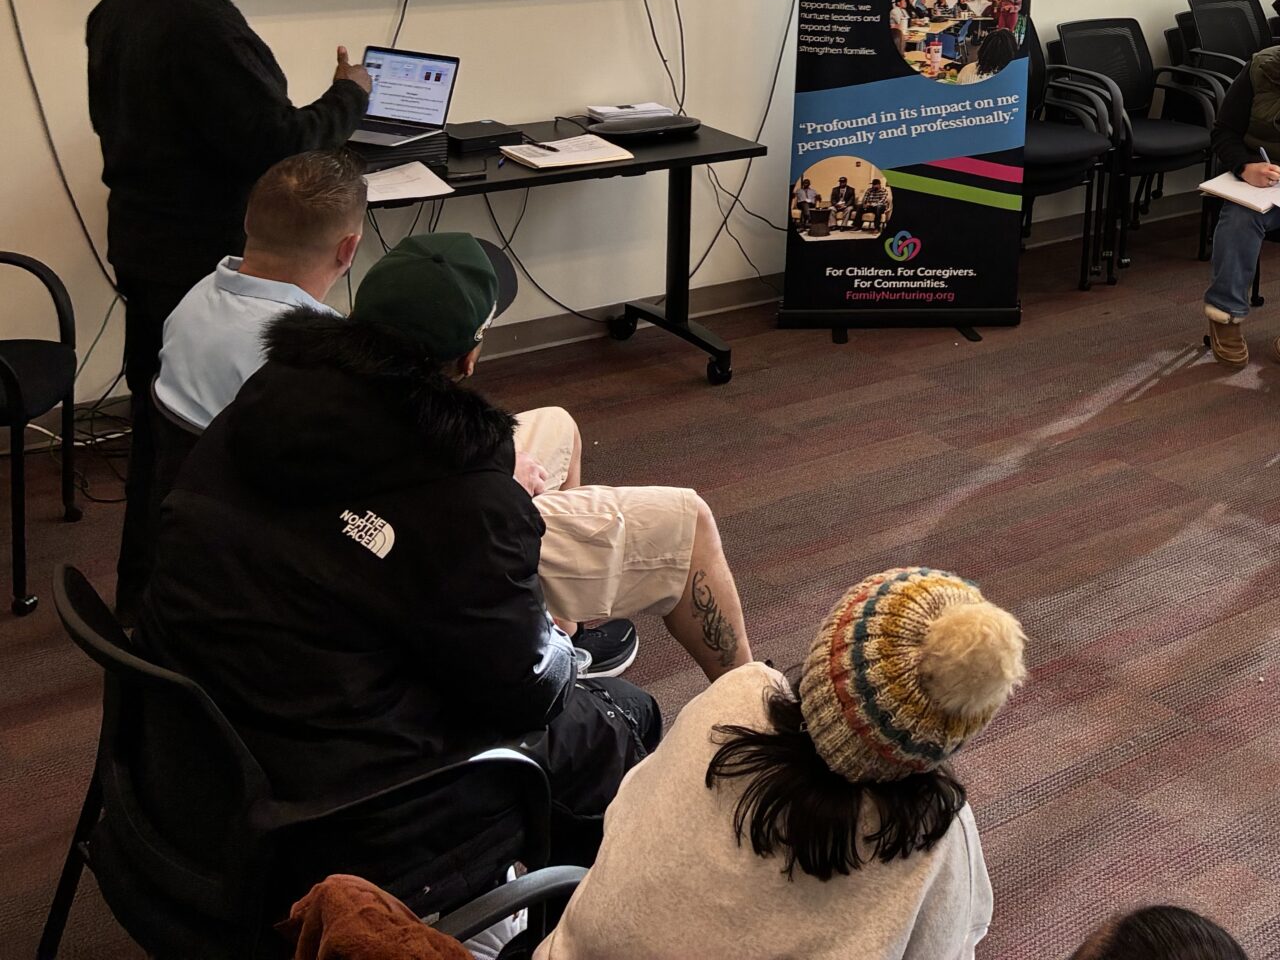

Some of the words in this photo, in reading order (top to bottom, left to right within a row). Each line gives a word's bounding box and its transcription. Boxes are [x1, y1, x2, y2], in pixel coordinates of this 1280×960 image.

[801, 12, 830, 20] nurture
[831, 13, 862, 22] leaders
[863, 14, 880, 22] and
[800, 23, 831, 32] expand
[800, 34, 835, 44] capacity
[799, 113, 877, 135] “Profound
[880, 111, 896, 123] in
[900, 107, 918, 120] its
[920, 100, 971, 118] impact
[975, 98, 994, 110] on
[996, 94, 1019, 106] me
[796, 130, 876, 155] personally
[879, 124, 907, 140] and
[911, 107, 1019, 137] professionally.”
[825, 267, 843, 277] For
[845, 266, 895, 277] Children.
[897, 267, 915, 277] For
[917, 266, 977, 279] Caregivers.
[854, 278, 871, 288] For
[874, 278, 948, 289] Communities.
[846, 290, 955, 302] FamilyNurturing.org
[339, 509, 380, 540] NORTH
[364, 510, 387, 530] THE
[341, 524, 373, 547] FACE
